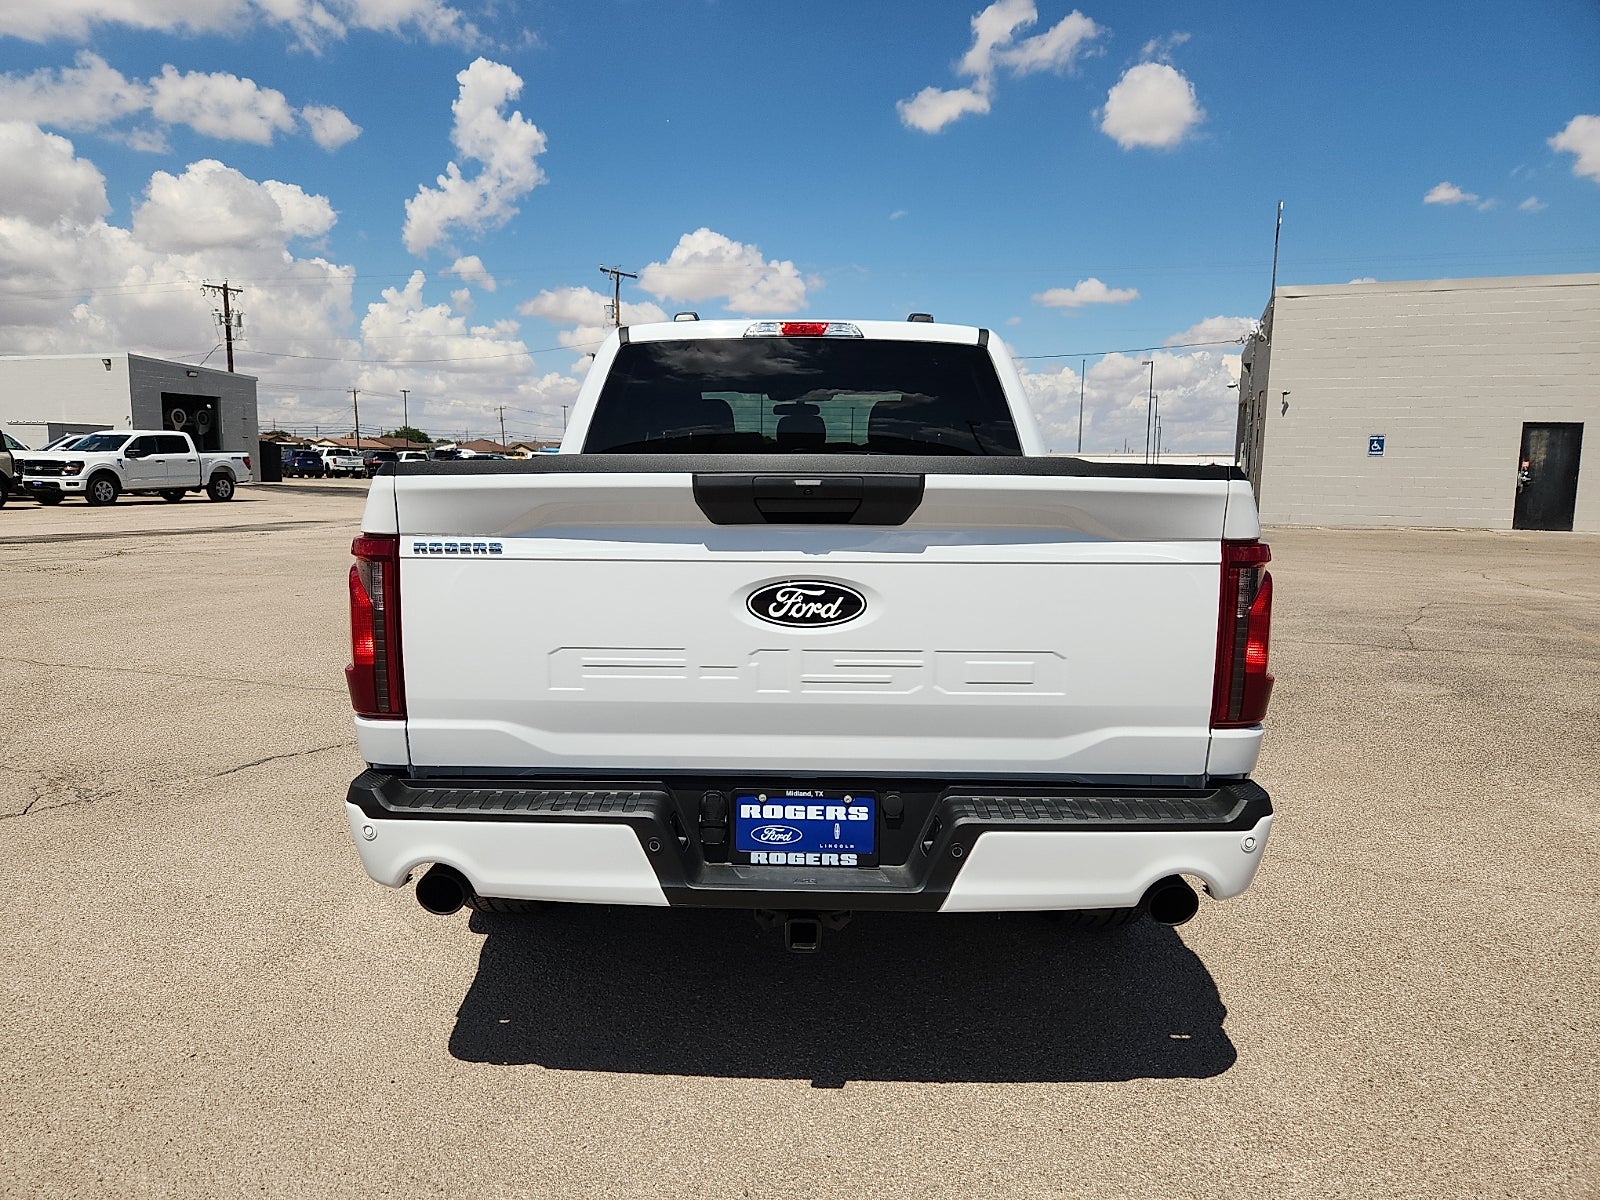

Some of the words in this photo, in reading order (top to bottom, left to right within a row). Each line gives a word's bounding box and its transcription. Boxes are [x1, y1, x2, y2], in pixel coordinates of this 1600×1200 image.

[413, 542, 503, 555] ROGERS
[768, 586, 844, 619] Ford
[547, 646, 1068, 697] F-150
[785, 790, 814, 798] Midland,
[814, 790, 824, 798] TX
[740, 804, 869, 821] ROGERS
[760, 827, 793, 842] Ford
[750, 851, 858, 866] ROGERS
